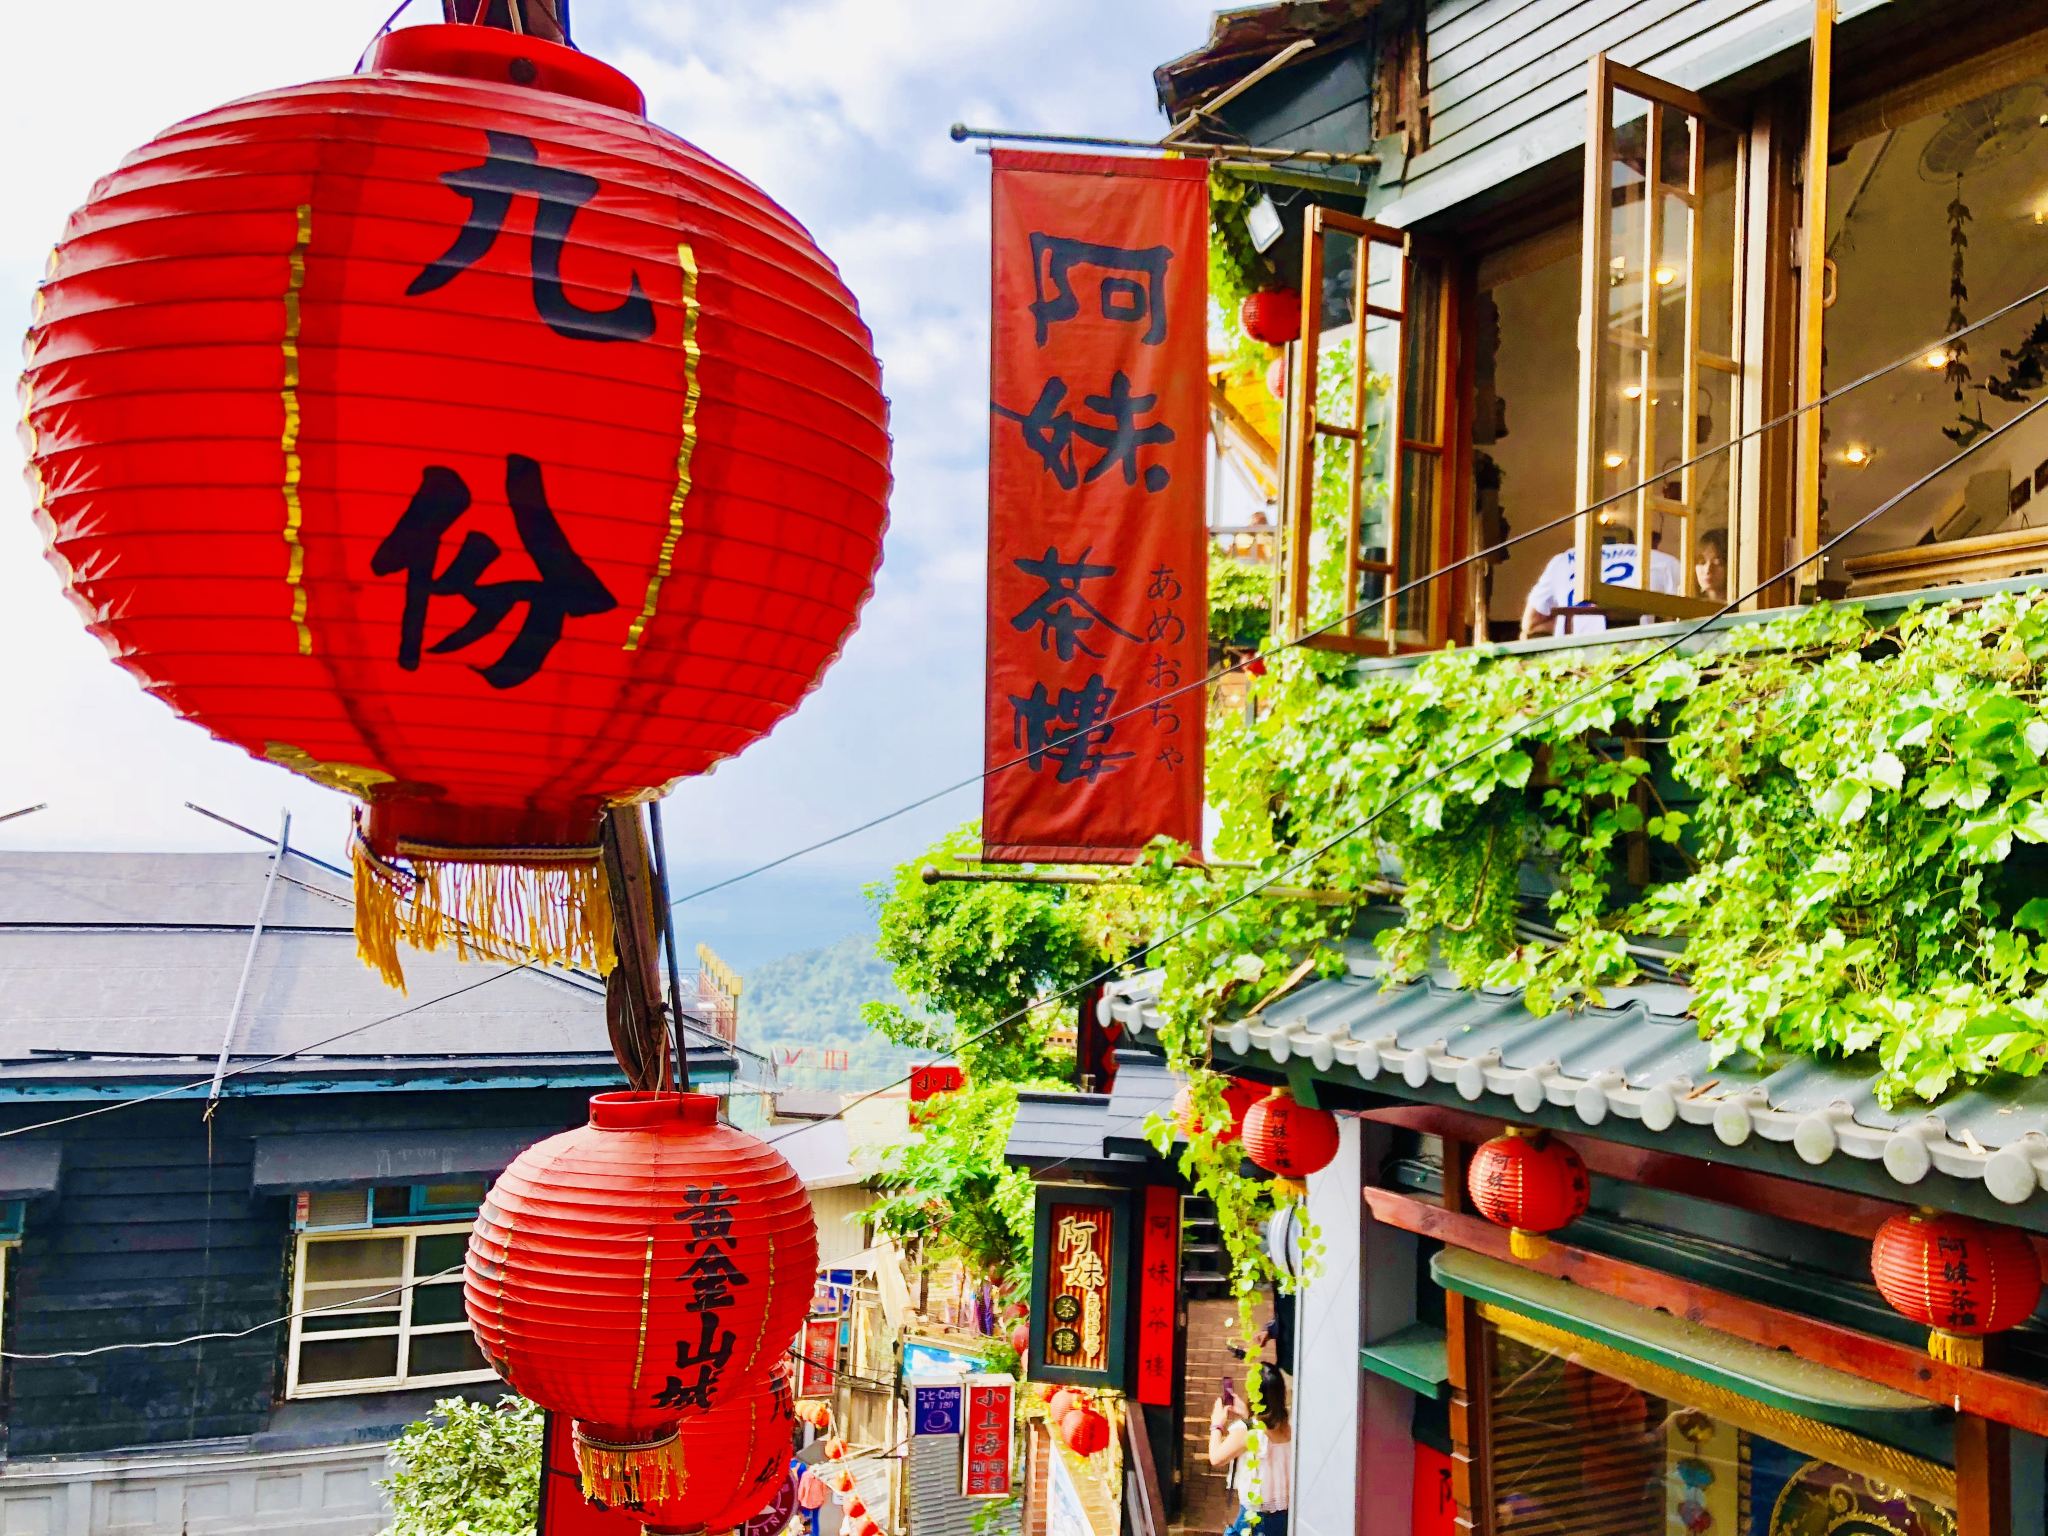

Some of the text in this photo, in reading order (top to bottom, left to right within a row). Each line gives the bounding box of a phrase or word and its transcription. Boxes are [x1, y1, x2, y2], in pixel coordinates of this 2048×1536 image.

[371, 131, 656, 688] 九份
[990, 232, 1175, 784] 阿妹茶樓
[1147, 563, 1186, 772] あめおちゃ
